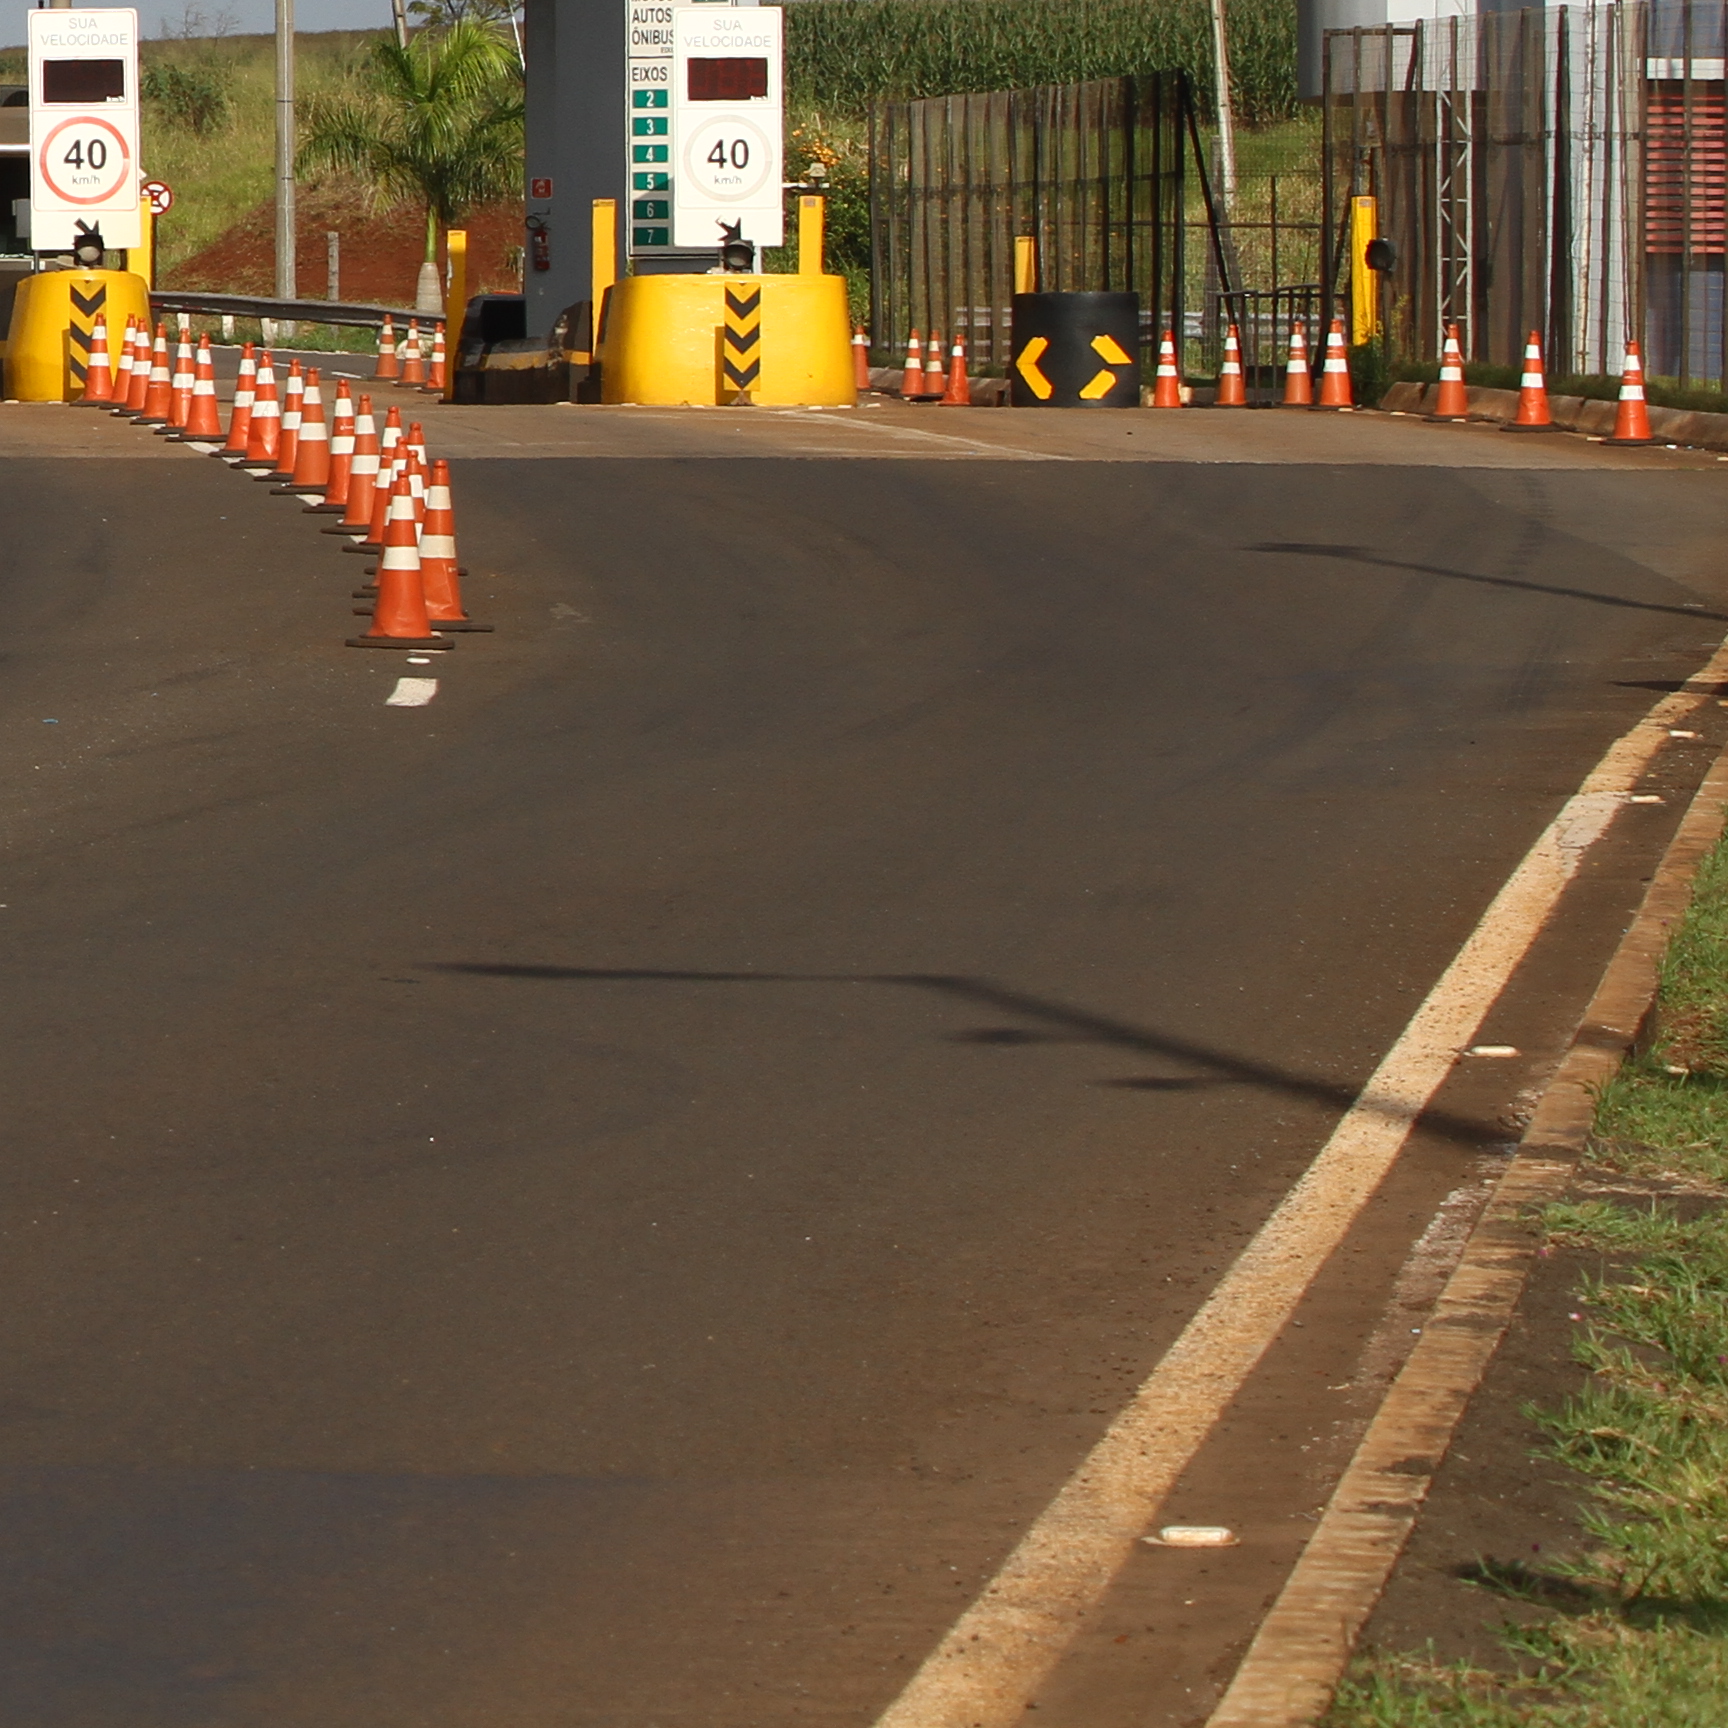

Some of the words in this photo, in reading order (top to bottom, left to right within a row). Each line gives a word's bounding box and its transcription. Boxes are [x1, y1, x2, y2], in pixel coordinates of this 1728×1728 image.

[68, 17, 98, 30] SUA
[631, 7, 673, 24] AUTOS
[713, 18, 743, 31] SUA
[40, 33, 128, 46] VELOCIDADE
[683, 35, 772, 48] VELOCIDADE
[631, 66, 668, 83] EIXOS
[646, 91, 655, 107] 2
[646, 119, 655, 135] 3
[63, 138, 108, 170] 40
[645, 146, 654, 162] 4
[707, 139, 750, 170] 40
[71, 174, 101, 185] km/h
[646, 174, 655, 190] 5
[713, 175, 742, 186] km/h
[646, 202, 655, 218] 6
[647, 229, 654, 244] 7
